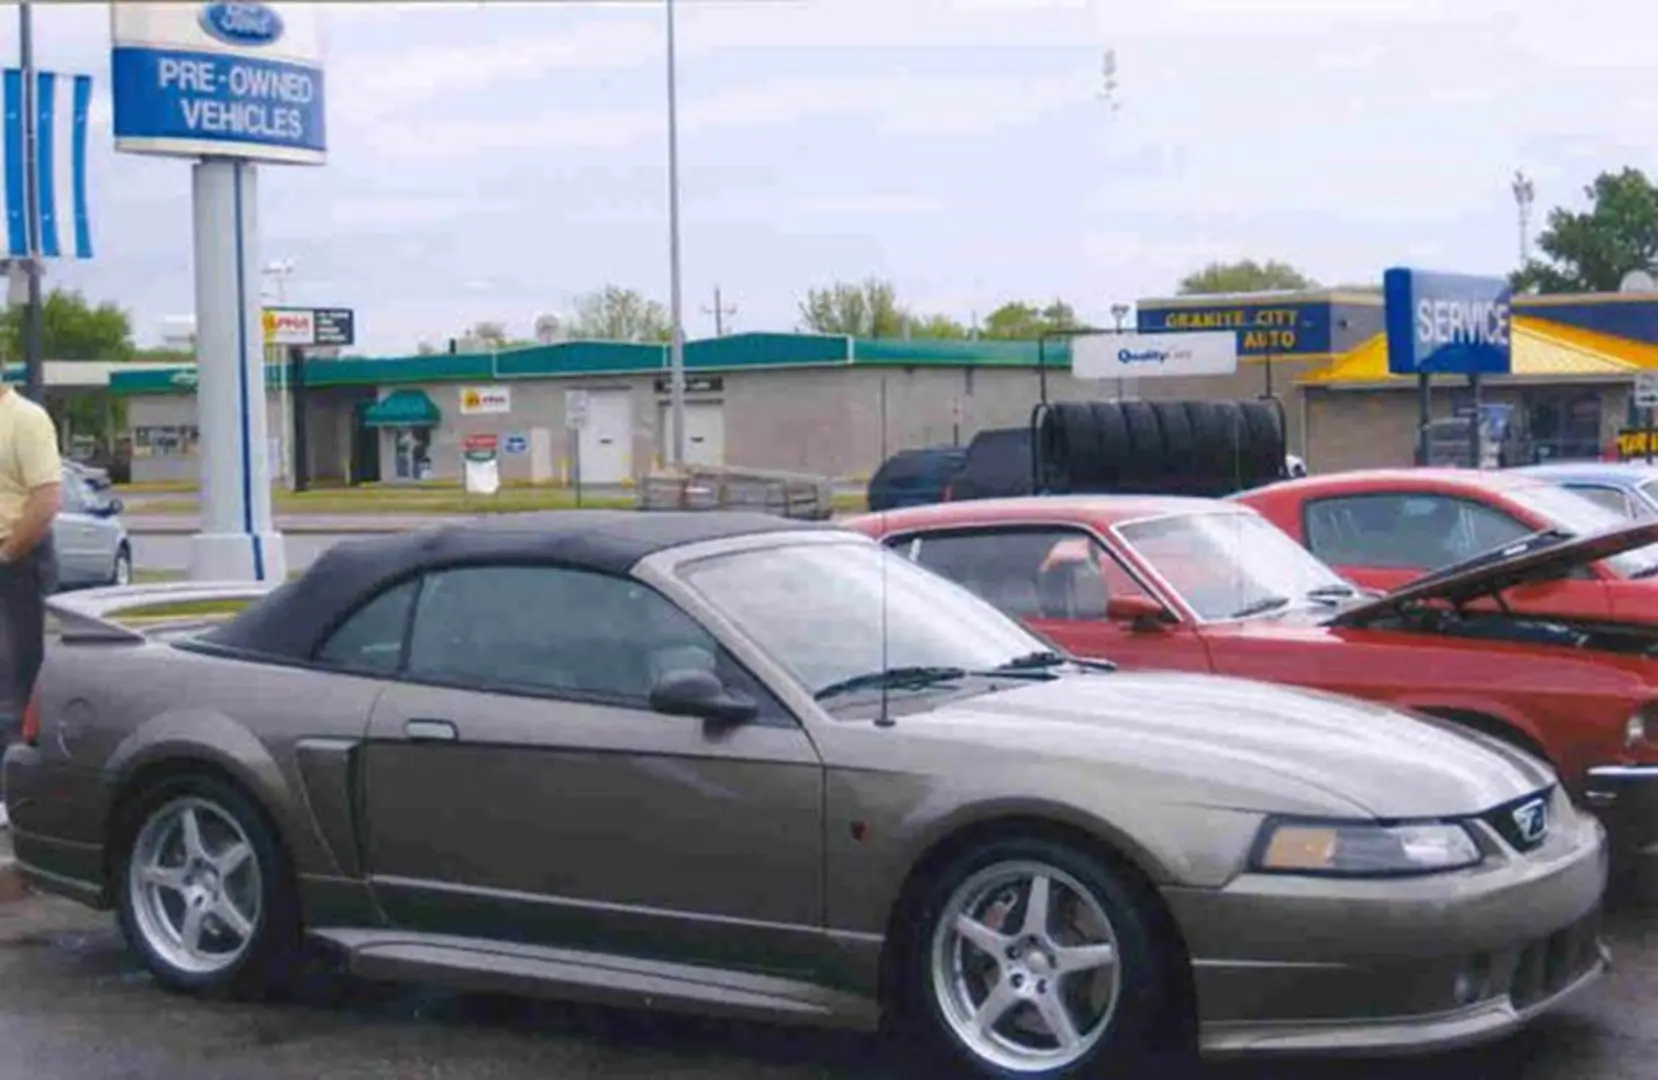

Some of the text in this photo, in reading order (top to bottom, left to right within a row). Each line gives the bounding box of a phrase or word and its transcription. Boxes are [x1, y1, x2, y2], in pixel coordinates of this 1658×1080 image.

[158, 58, 313, 103] PRE-OWNED
[180, 99, 303, 138] VEHICLES
[1165, 310, 1298, 328] GRANITE CITY
[1418, 299, 1509, 345] SERVICE
[1244, 330, 1296, 349] AUTO
